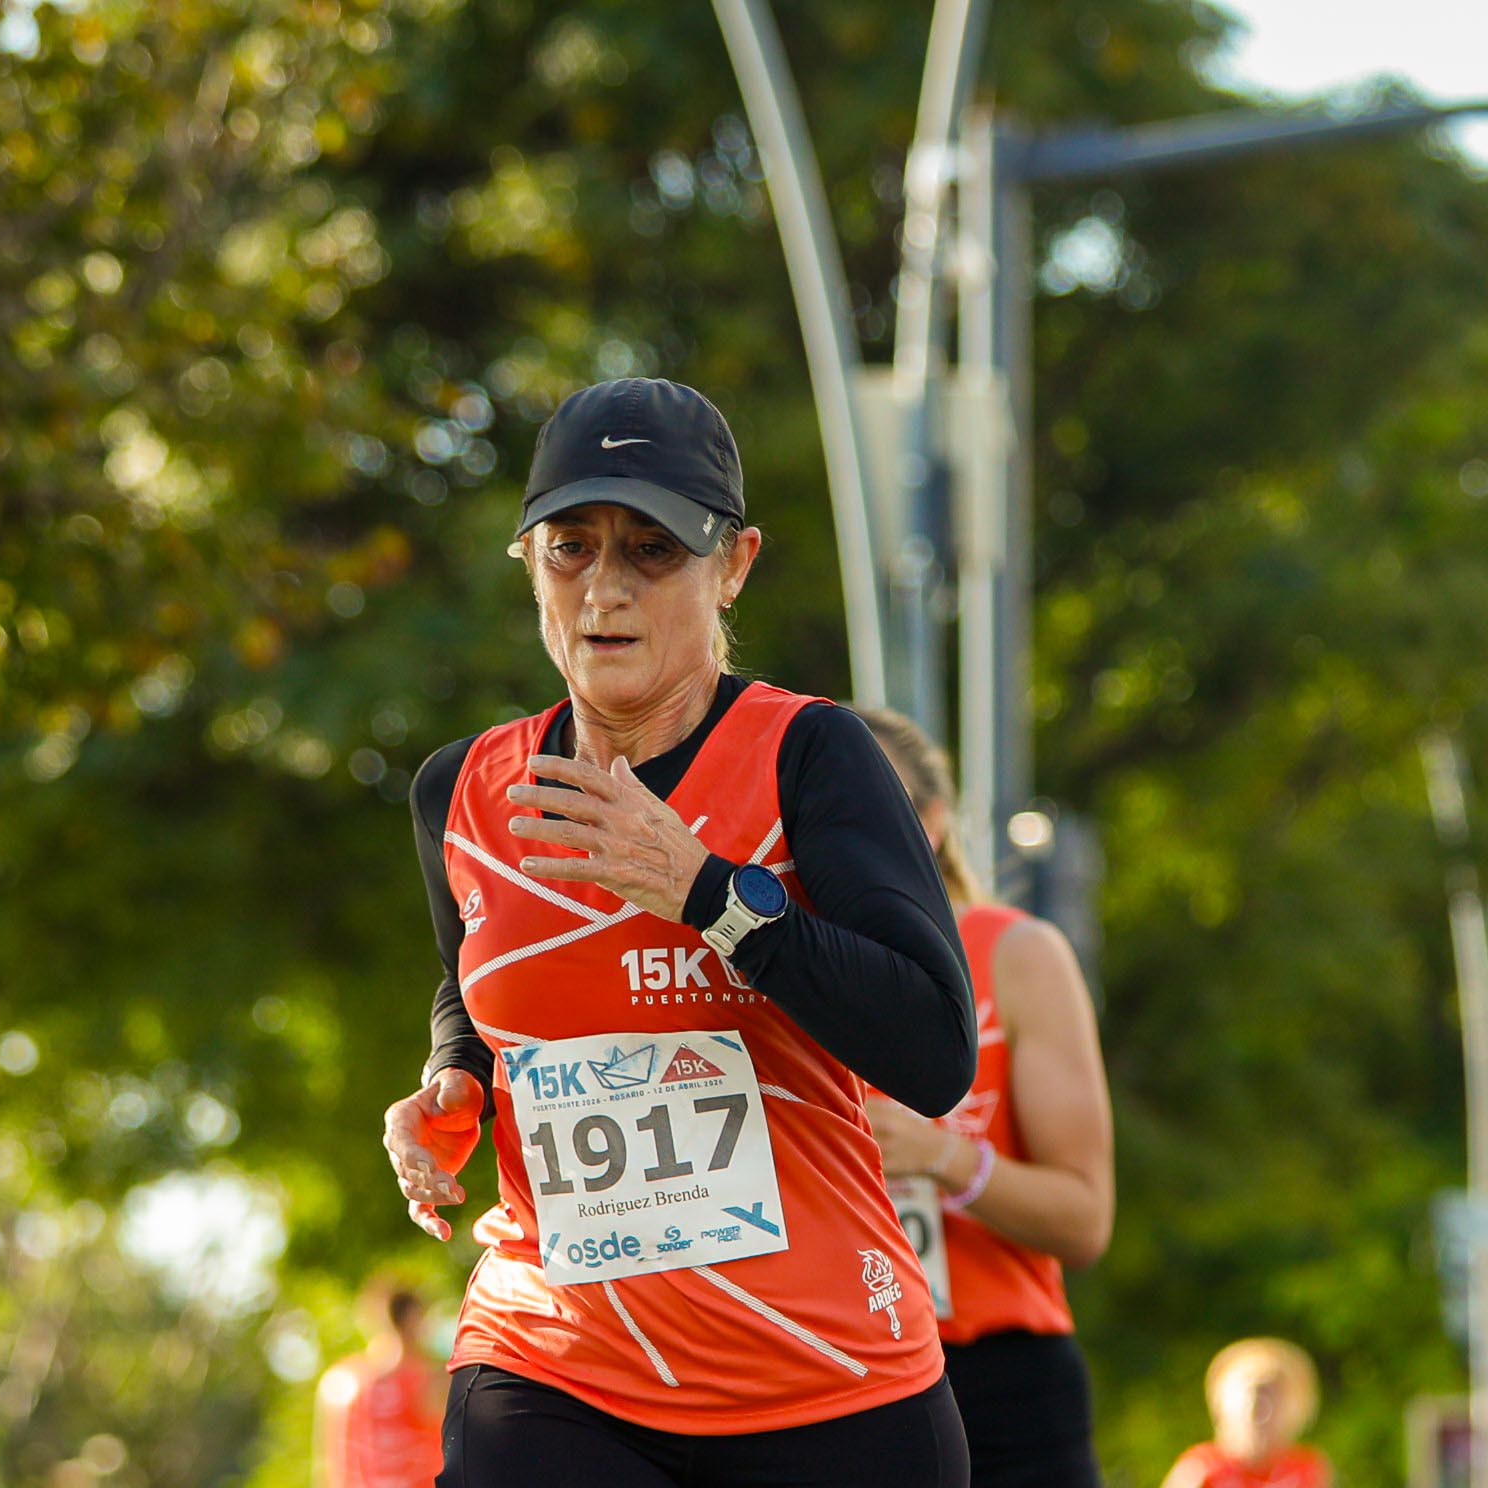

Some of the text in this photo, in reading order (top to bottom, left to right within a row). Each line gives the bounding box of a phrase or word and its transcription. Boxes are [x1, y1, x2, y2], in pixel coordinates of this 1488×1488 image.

[621, 947, 710, 991] 15K
[631, 992, 768, 1005] PUERTO NORT
[527, 1061, 587, 1100] 15K
[672, 1059, 710, 1076] 15K
[532, 1103, 557, 1112] PUERTO
[558, 1100, 580, 1109] NORTE
[582, 1098, 601, 1106] 2026
[609, 1090, 645, 1102] ROSARIO
[653, 1087, 664, 1095] 12
[665, 1085, 676, 1093] DE
[678, 1083, 702, 1091] ABRIL
[704, 1079, 724, 1088] 2026
[529, 1093, 749, 1196] 1917
[578, 1184, 710, 1217] Rodriguez Brenda
[567, 1231, 641, 1266] osde
[701, 1225, 742, 1239] POWER
[868, 1282, 903, 1313] ARDEC
